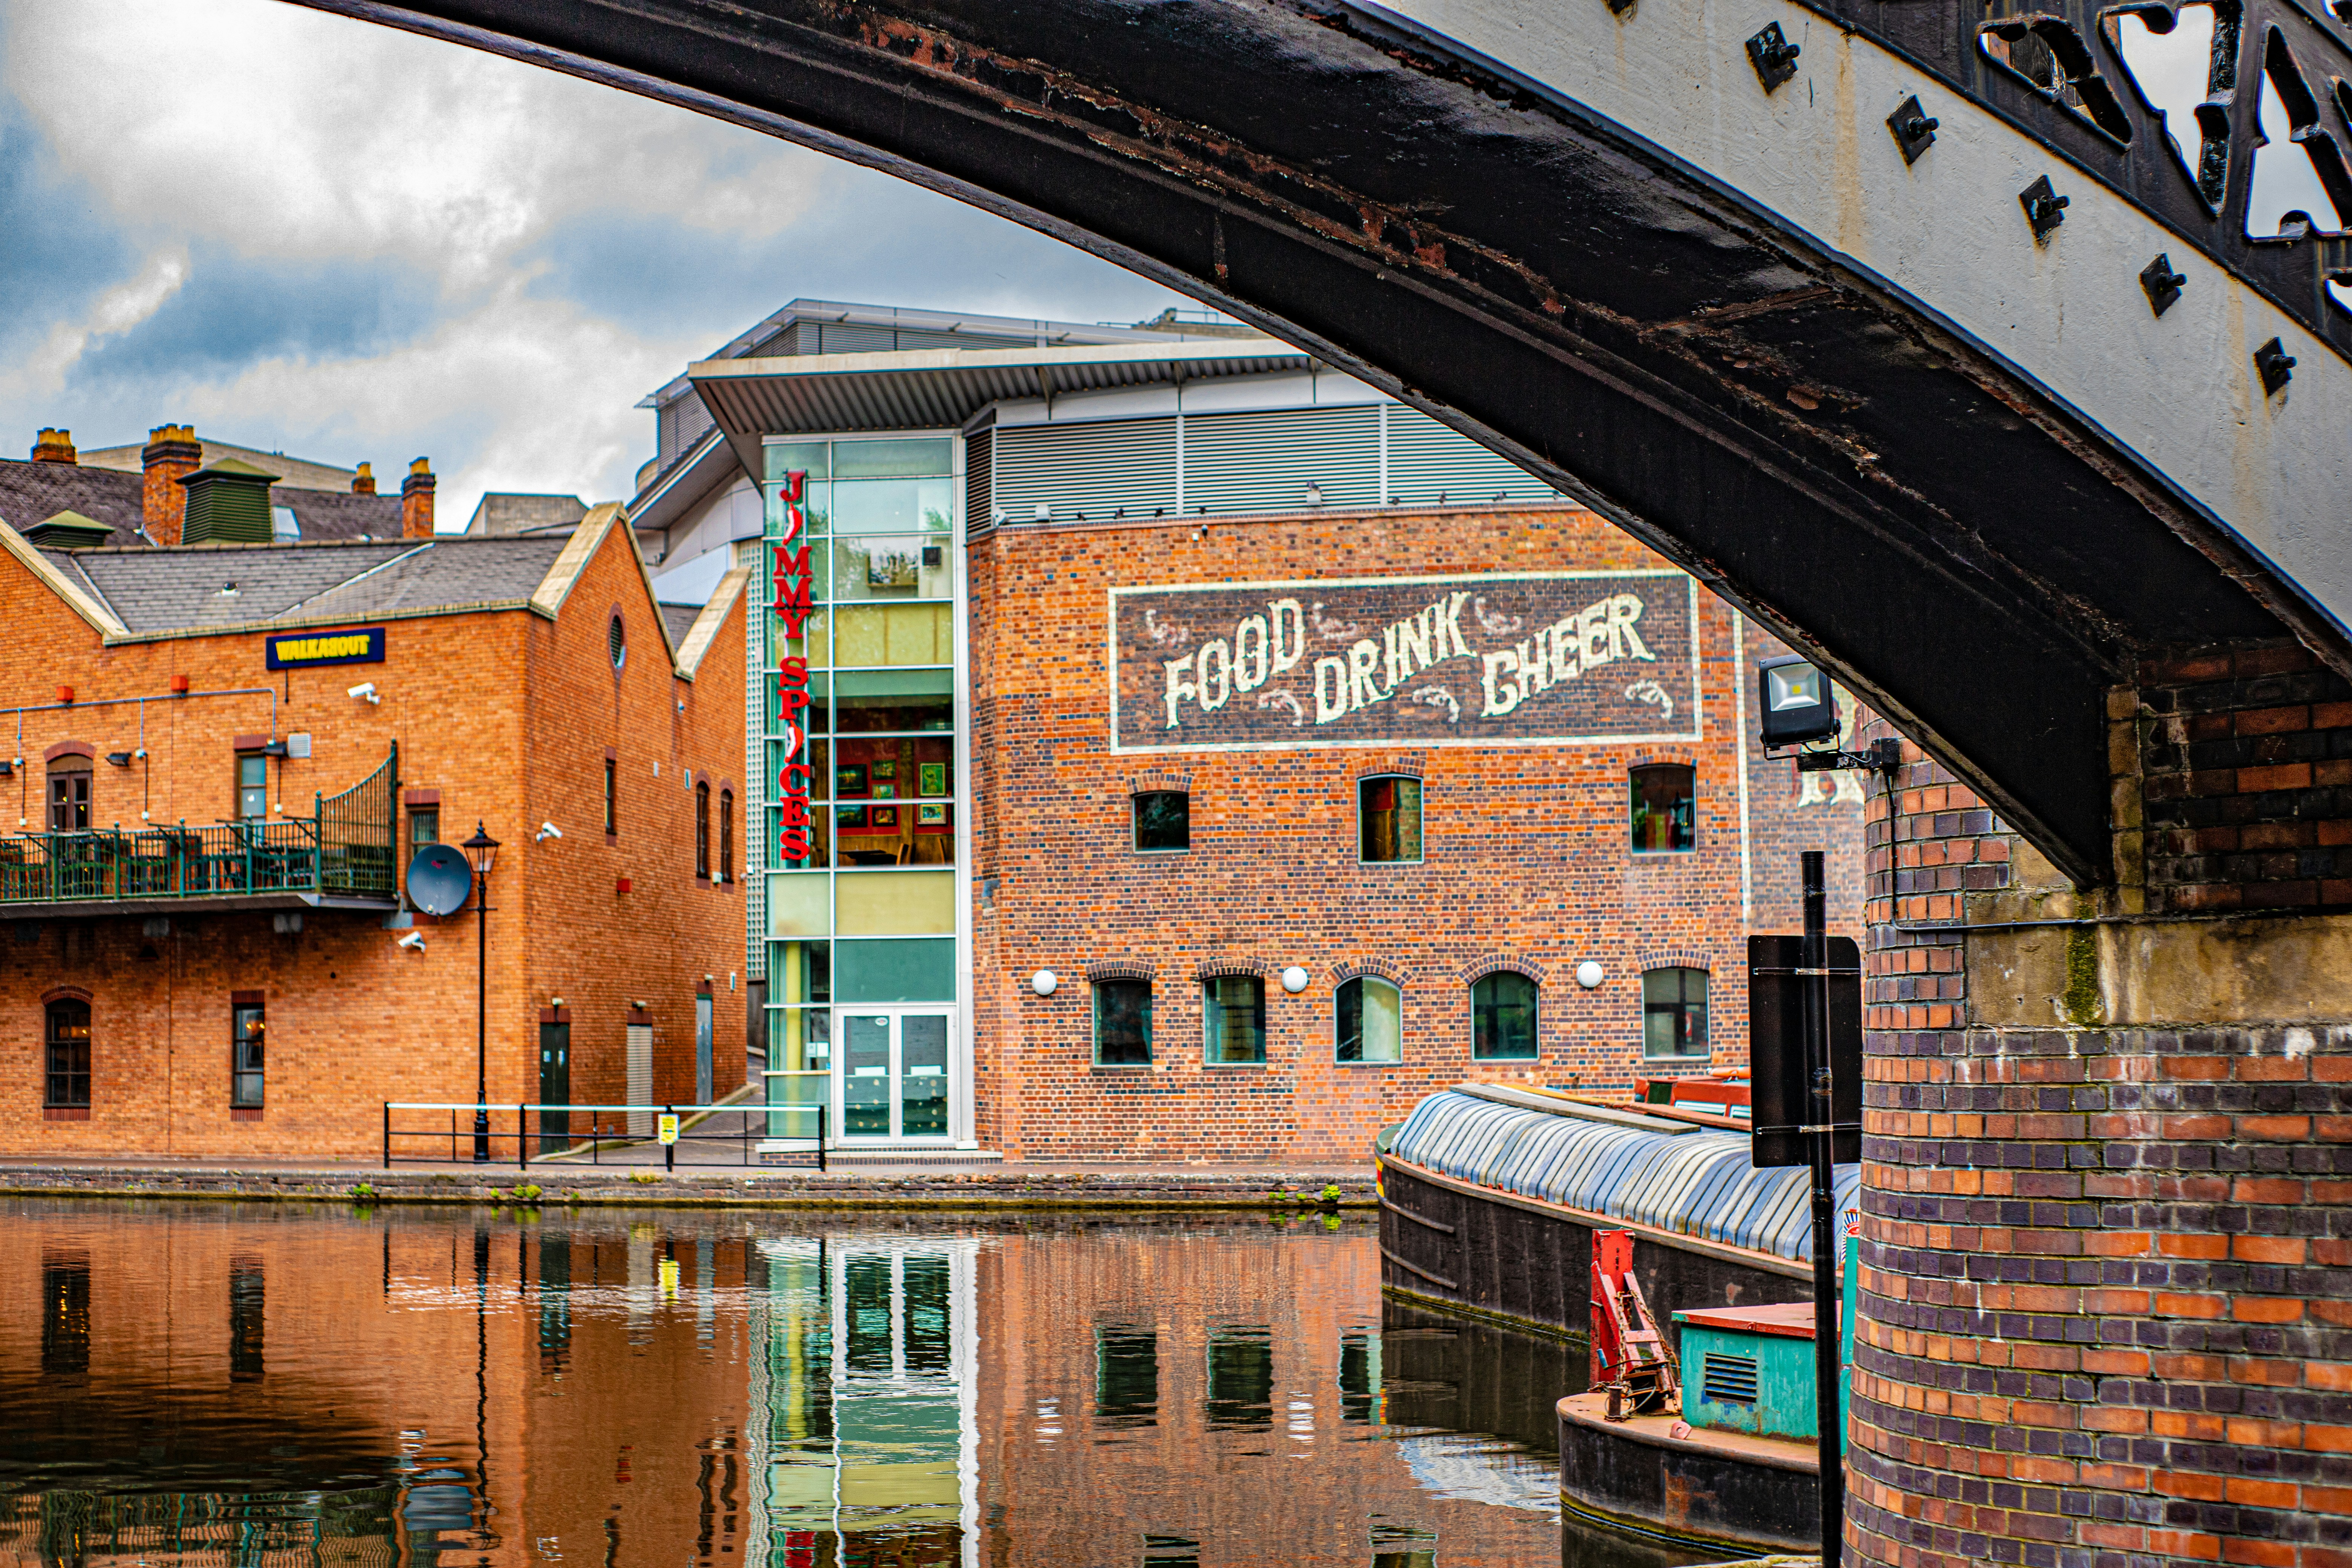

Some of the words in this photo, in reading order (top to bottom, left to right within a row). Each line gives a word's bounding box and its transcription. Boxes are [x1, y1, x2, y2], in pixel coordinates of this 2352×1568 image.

[276, 635, 370, 662] WALKABOUT
[1162, 597, 1306, 729] FOOD
[1313, 590, 1478, 725] DRINK
[1481, 593, 1656, 718] CHEER
